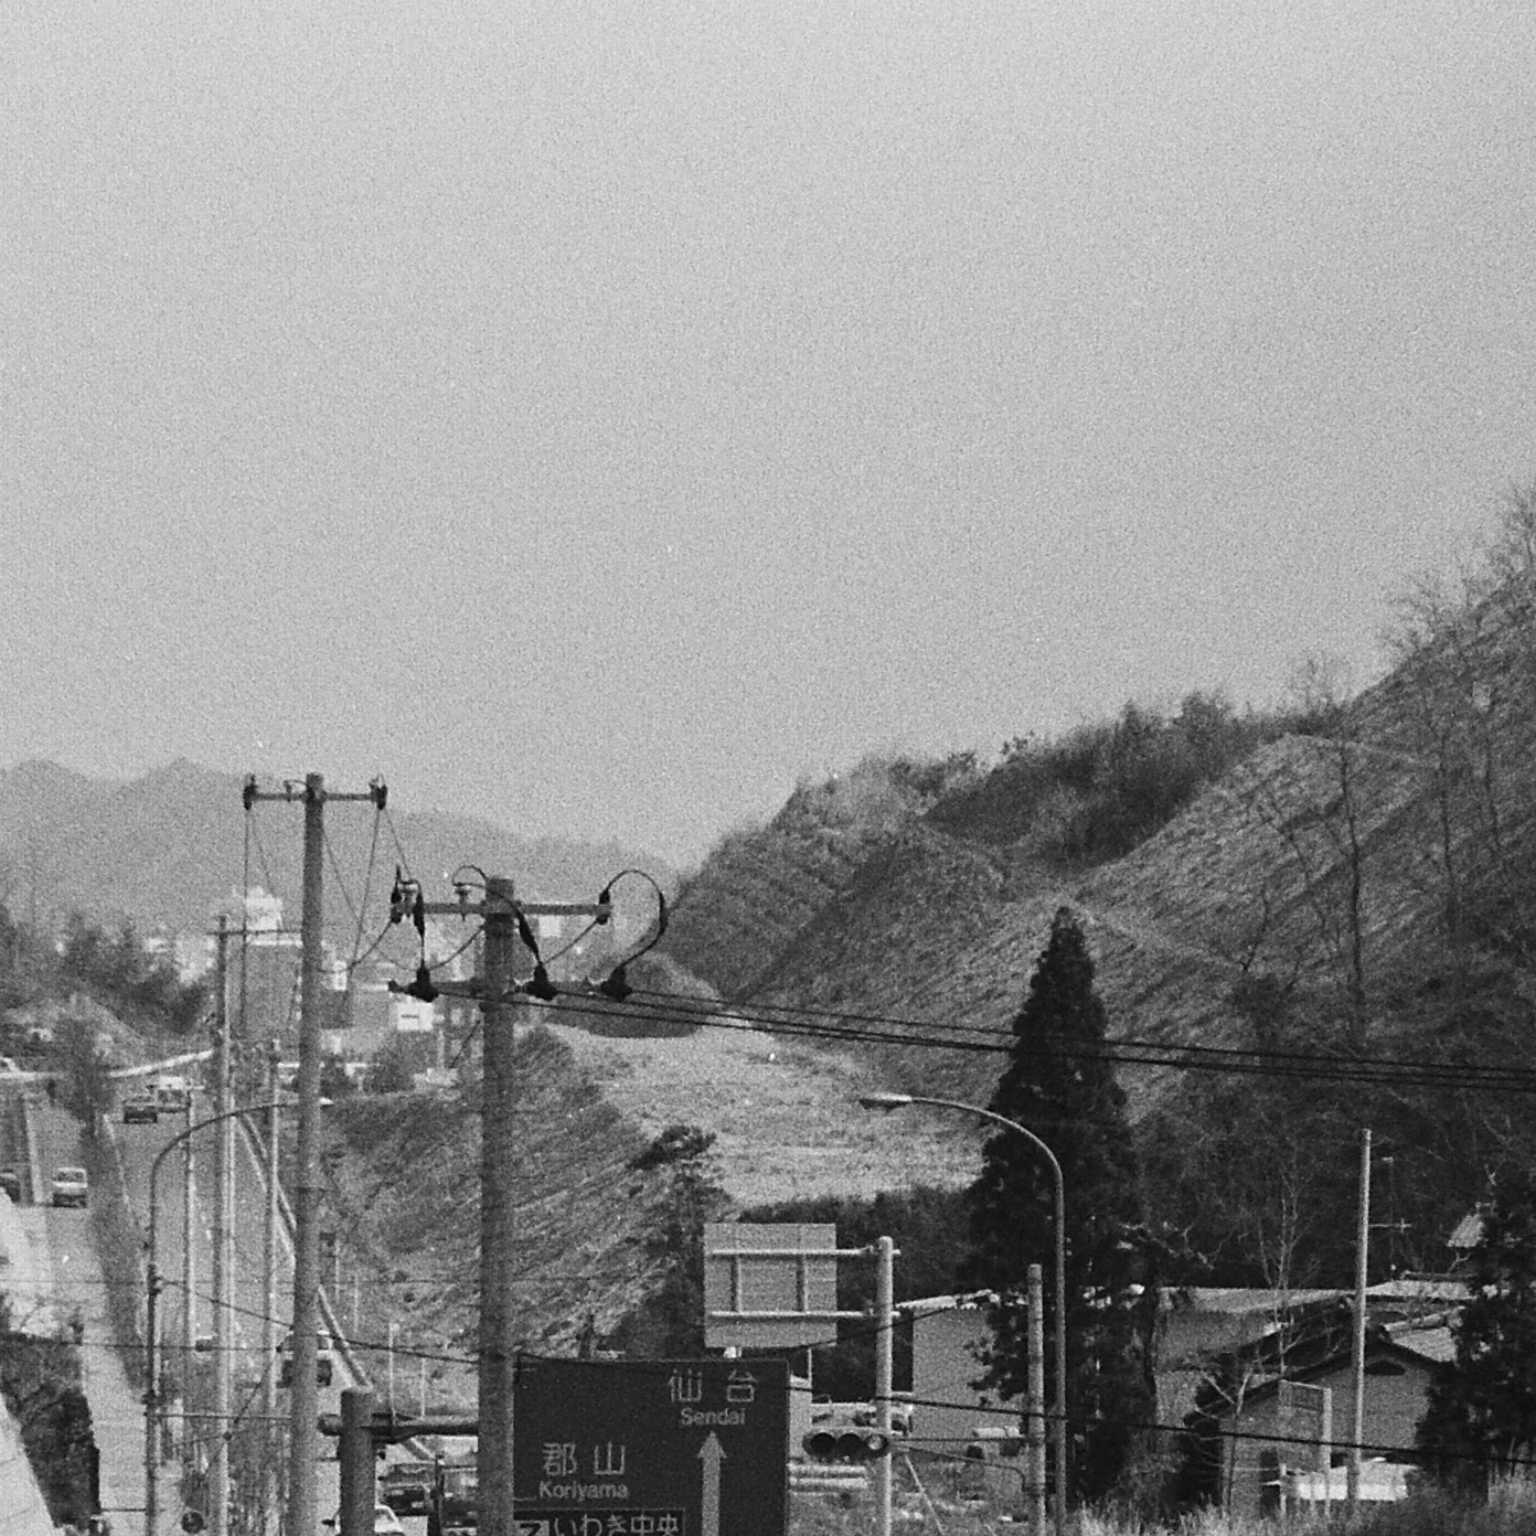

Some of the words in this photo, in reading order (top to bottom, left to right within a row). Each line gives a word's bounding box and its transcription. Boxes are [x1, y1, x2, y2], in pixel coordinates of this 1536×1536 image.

[667, 1368, 758, 1402] 仙台
[681, 1407, 746, 1425] Sendai
[542, 1441, 626, 1476] 郡山
[539, 1480, 628, 1502] Koriyama
